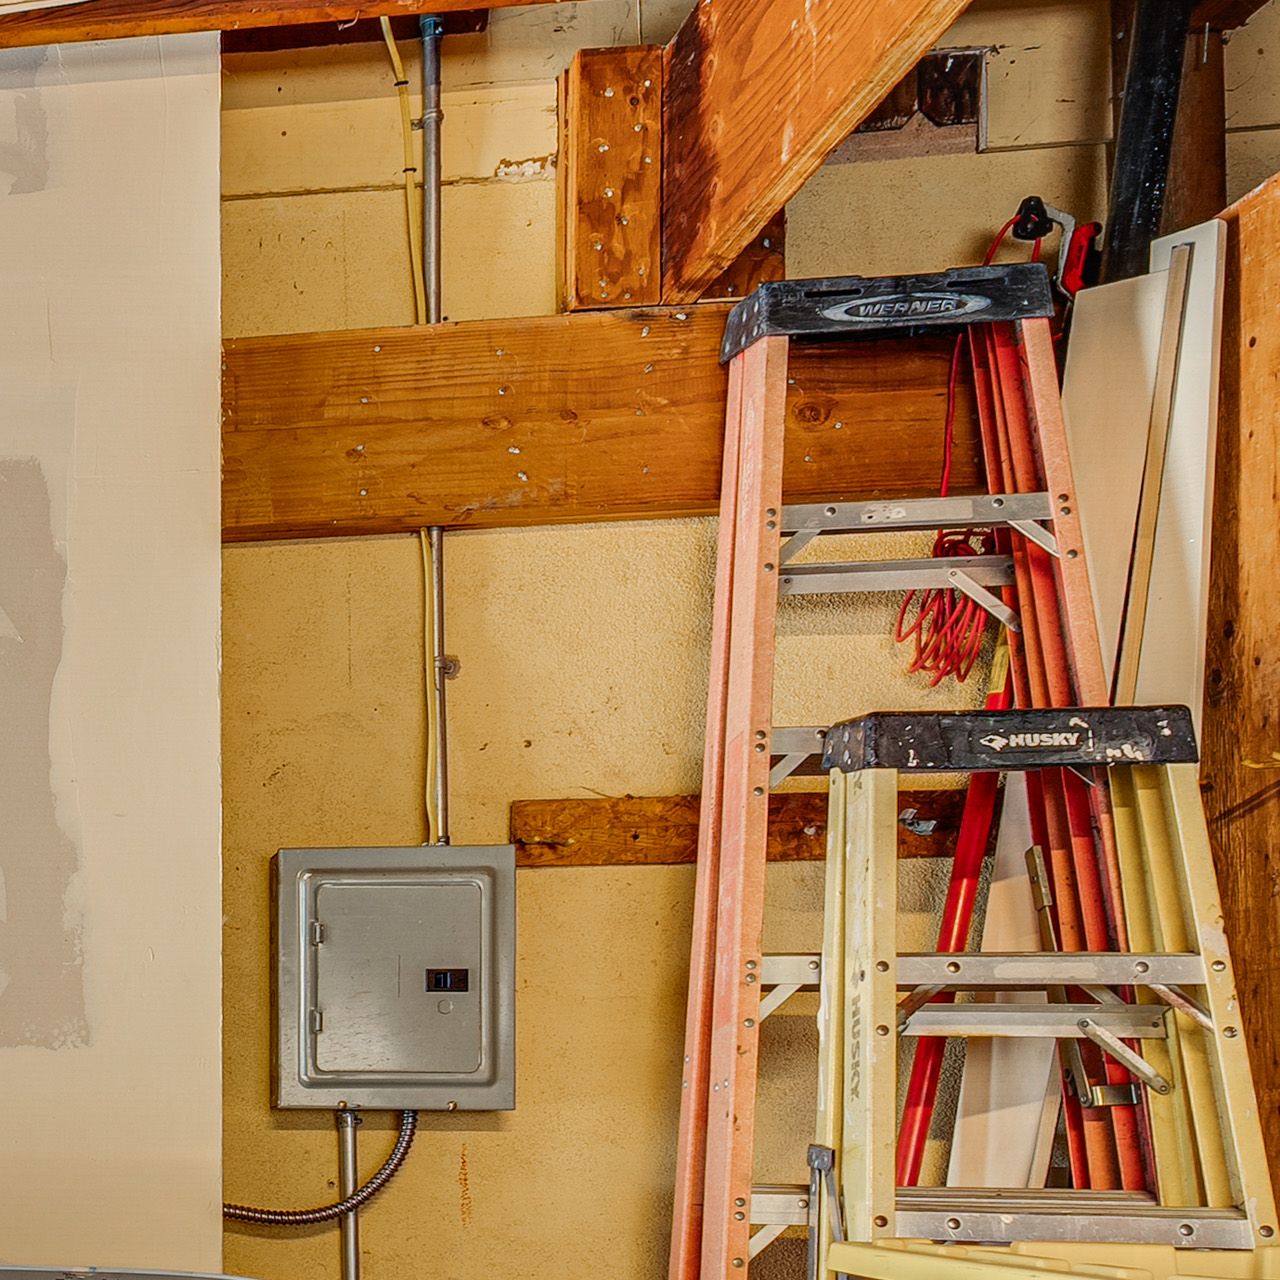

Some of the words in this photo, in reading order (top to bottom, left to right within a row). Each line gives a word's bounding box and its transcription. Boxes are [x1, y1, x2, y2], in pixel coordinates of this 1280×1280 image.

[858, 298, 958, 318] WERNER
[1007, 731, 1082, 749] HUSKY
[850, 993, 861, 1102] HUSKY
